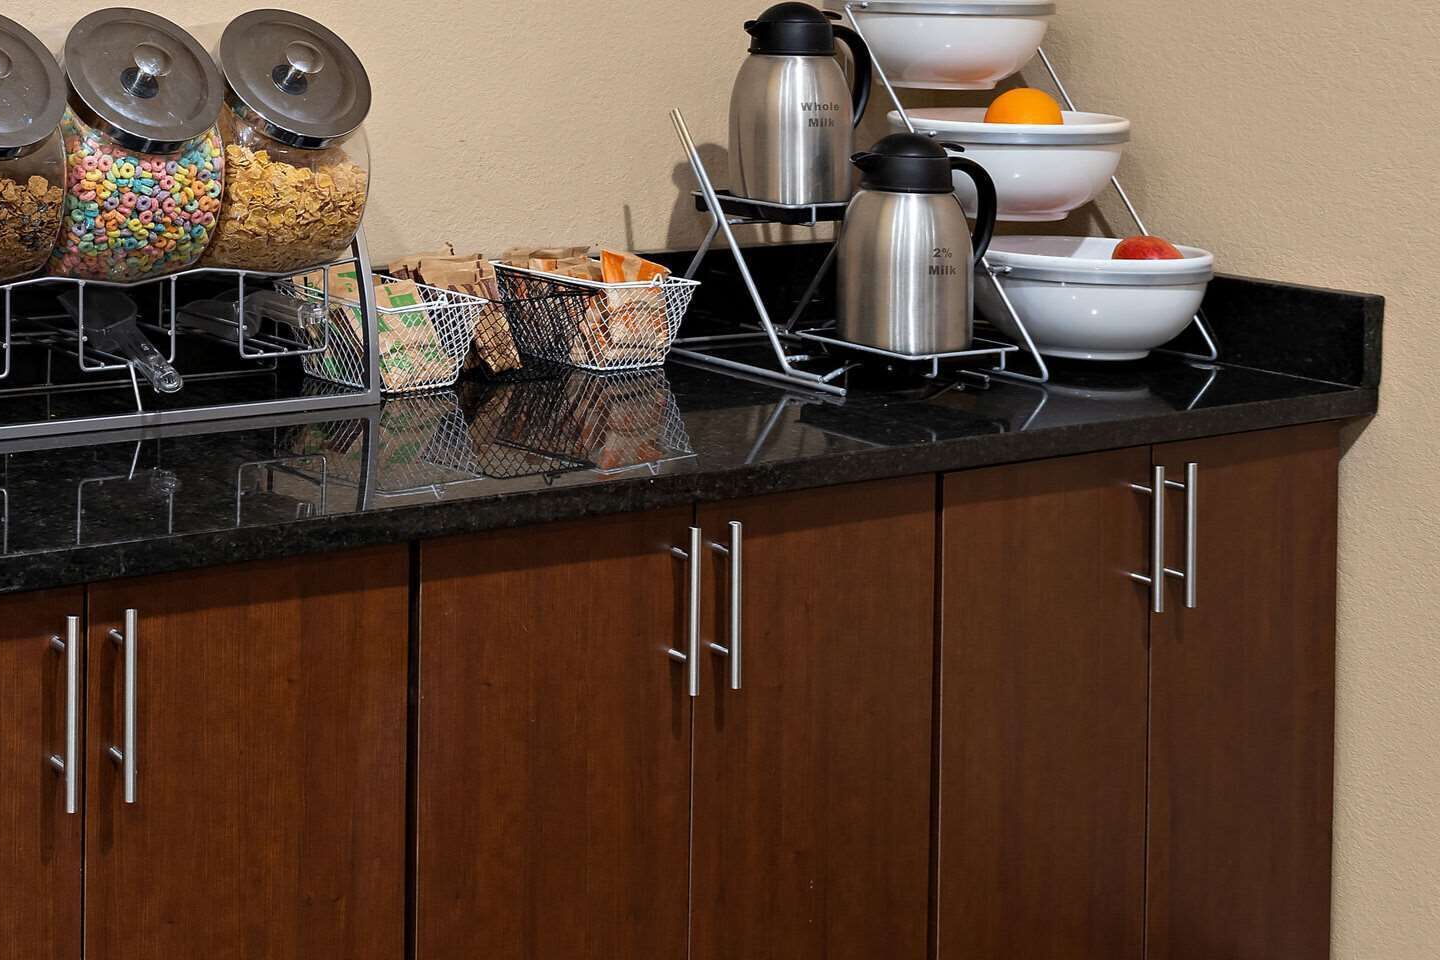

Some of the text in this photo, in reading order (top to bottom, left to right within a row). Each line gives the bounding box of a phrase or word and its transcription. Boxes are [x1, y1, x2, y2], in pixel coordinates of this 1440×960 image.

[801, 102, 840, 111] Whole
[808, 118, 835, 127] Milk
[933, 248, 952, 258] 2%
[929, 265, 956, 275] Milk
